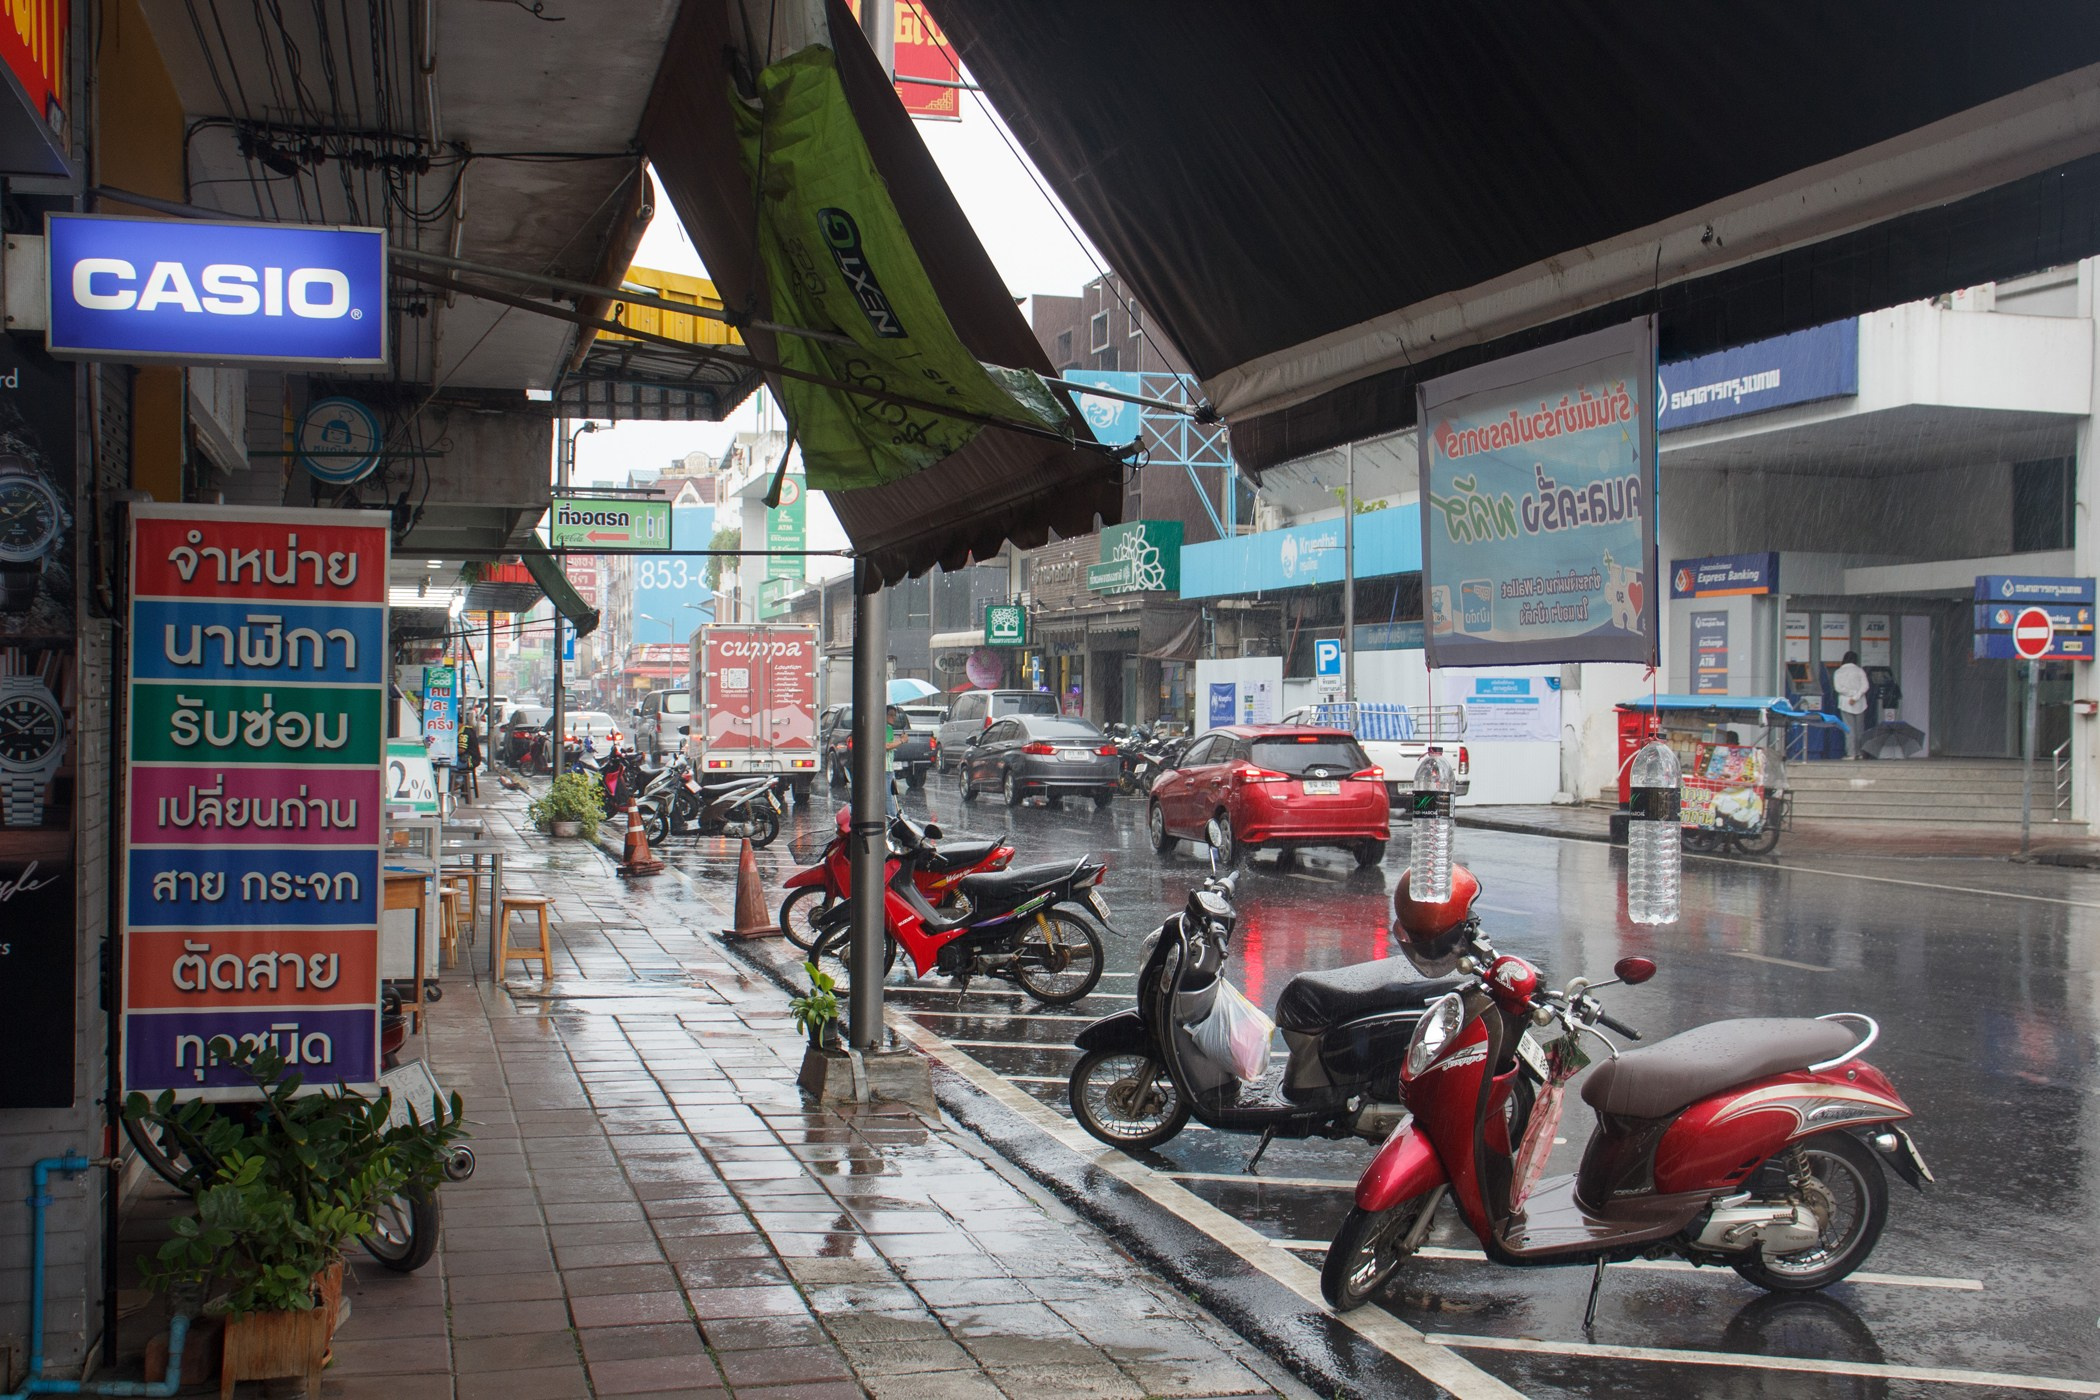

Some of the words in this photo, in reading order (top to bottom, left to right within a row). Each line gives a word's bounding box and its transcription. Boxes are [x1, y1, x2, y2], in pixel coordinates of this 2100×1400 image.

[72, 257, 350, 319] CASIO
[840, 257, 898, 334] NEXT
[1671, 368, 1781, 410] ธนาคารกรุงเทพ
[558, 502, 630, 527] ที่จอดรถ
[1299, 532, 1338, 557] Krungthai
[167, 529, 358, 587] จำหน่าย
[1697, 572, 1726, 585] Express
[1727, 569, 1760, 582] Banking
[1866, 623, 1886, 631] ATM
[164, 614, 357, 669] นาฬิกา
[720, 640, 802, 663] cuppa
[1319, 644, 1338, 671] P
[1698, 657, 1716, 667] ATM
[429, 678, 451, 686] Food
[431, 686, 451, 697] คน
[432, 700, 449, 711] ละ
[169, 694, 349, 749] รับซ่อม
[427, 713, 454, 731] ครึ่ง
[157, 773, 358, 829] เปลี่ยนถ่าน
[152, 869, 224, 901] สาย
[241, 869, 359, 901] กระจก
[946, 867, 973, 883] Wave
[172, 940, 340, 991] ตัดสาย
[1494, 976, 1514, 991] HONDA
[175, 1023, 332, 1082] ทุกชนิด
